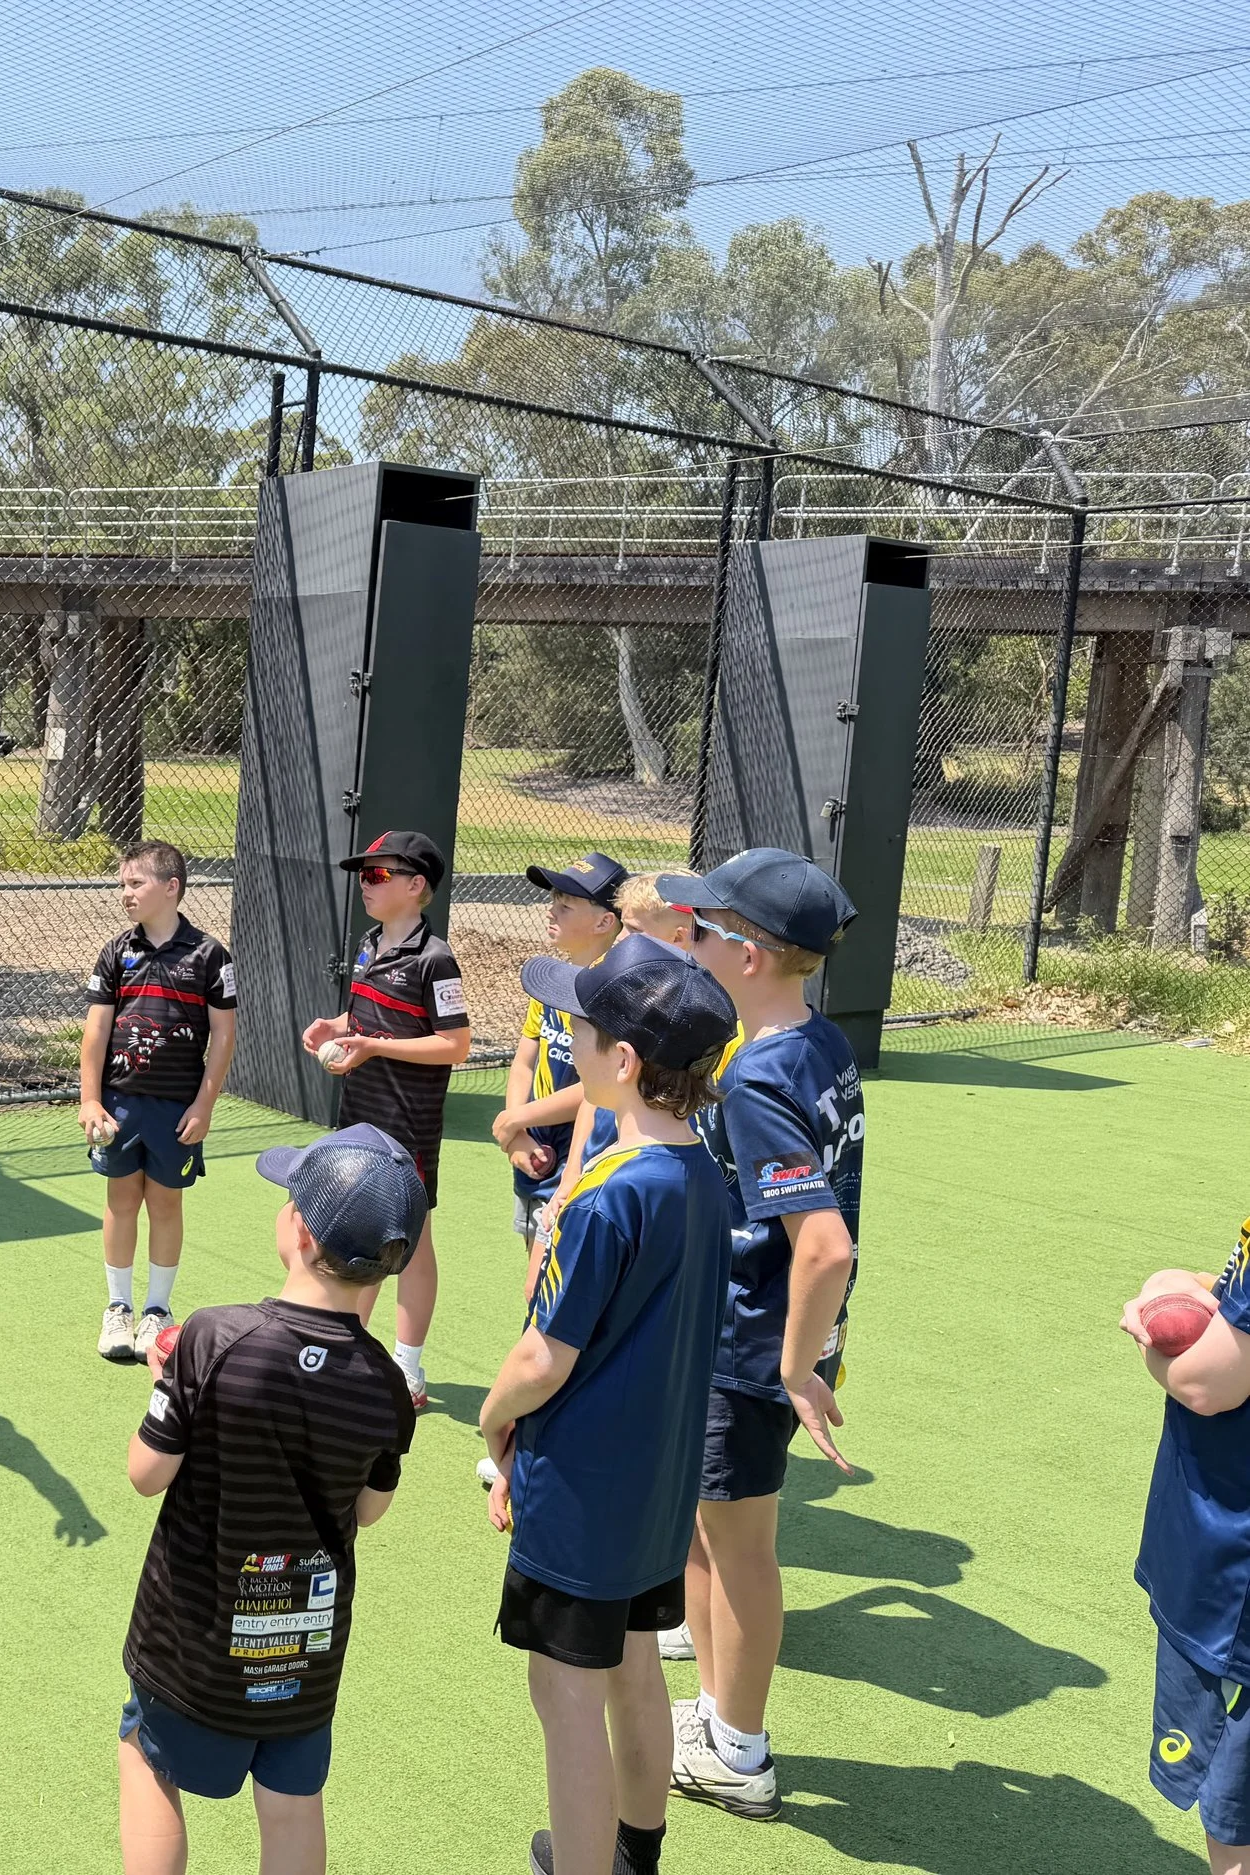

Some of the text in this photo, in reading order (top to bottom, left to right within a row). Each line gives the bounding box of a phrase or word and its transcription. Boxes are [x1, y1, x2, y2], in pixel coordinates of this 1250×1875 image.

[771, 1166, 811, 1182] SWIFT
[762, 1180, 826, 1198] 1800 SWIFTWATER
[263, 1554, 285, 1564] TOTAL
[299, 1555, 331, 1566] SUPERIO
[261, 1562, 285, 1572] TOOLS
[249, 1581, 291, 1593] MOTION
[235, 1613, 332, 1631] entry entry entry
[231, 1636, 266, 1648] PLENTY
[269, 1634, 300, 1647] VALLEY
[234, 1646, 295, 1656] PRINTING
[243, 1660, 309, 1675] MASH GARAGE DOORS
